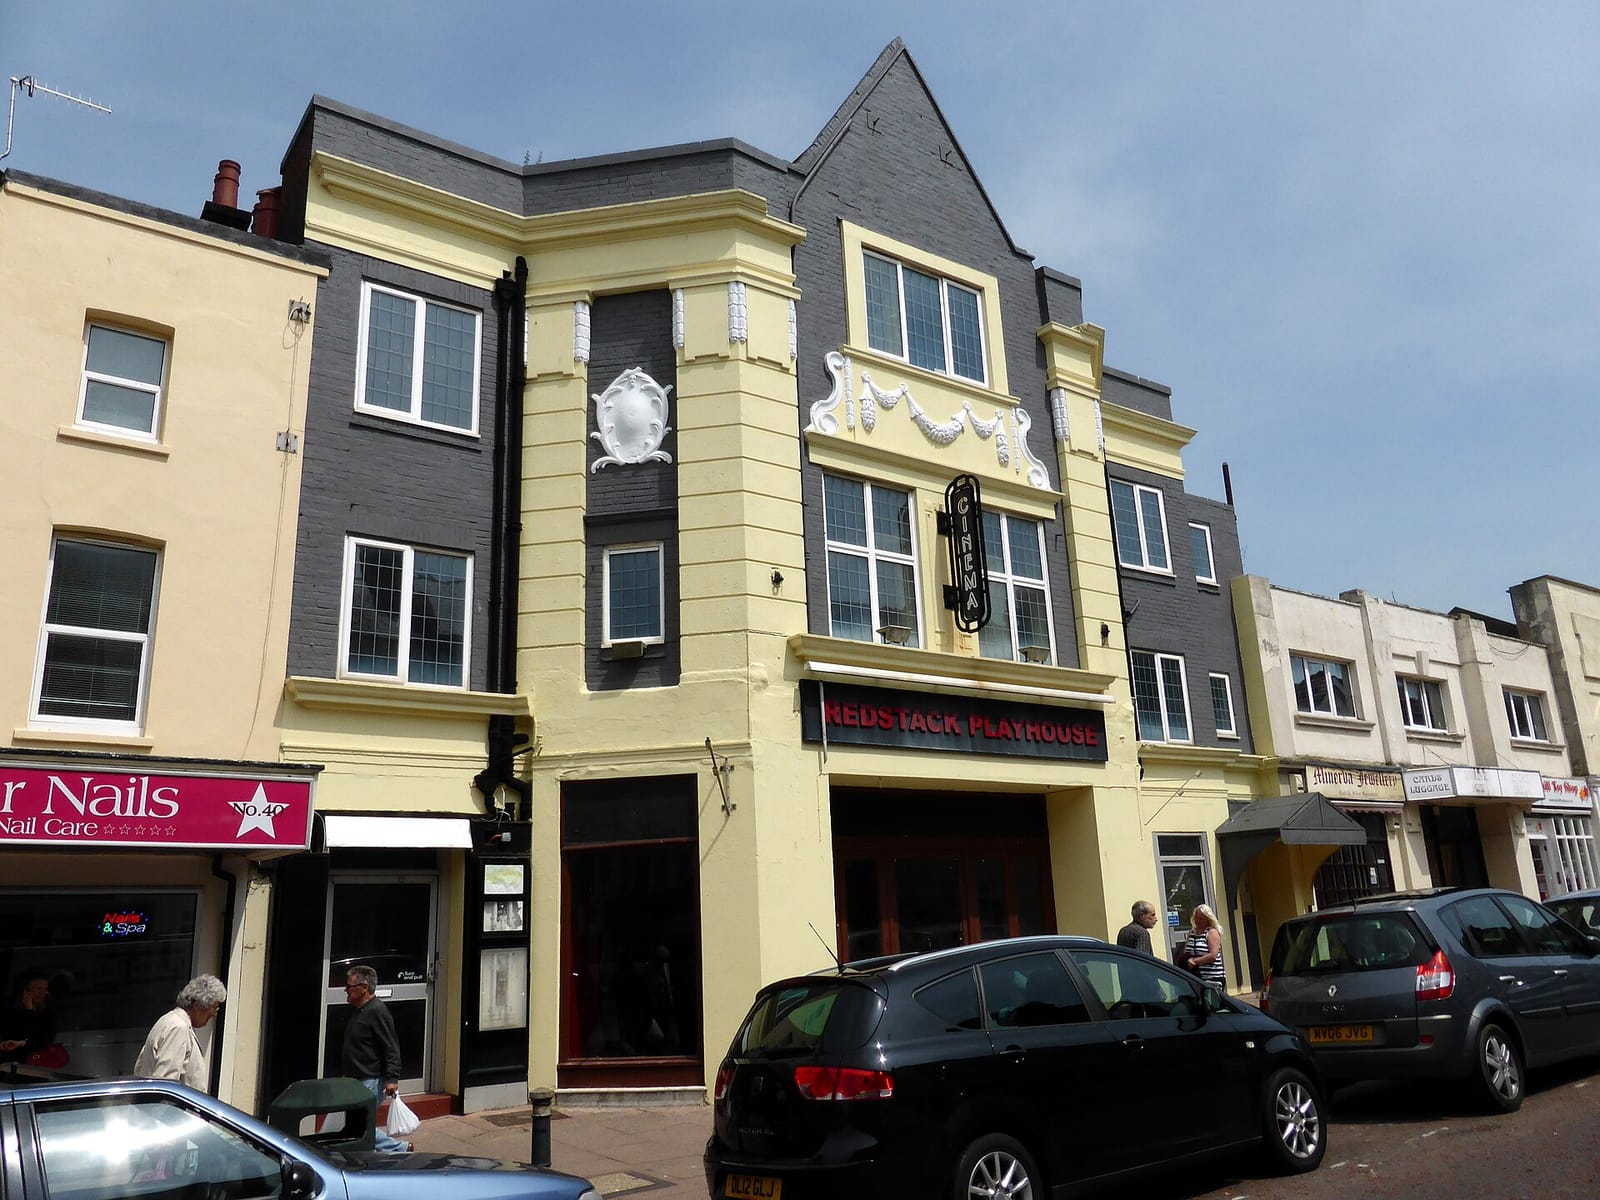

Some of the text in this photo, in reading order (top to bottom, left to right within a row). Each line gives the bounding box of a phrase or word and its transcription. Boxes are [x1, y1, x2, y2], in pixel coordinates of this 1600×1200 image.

[957, 496, 979, 611] CINEMA
[825, 700, 1098, 746] REDSTACK PLAYHOUSE
[1313, 766, 1398, 788] Minerva Jewellery
[1412, 774, 1443, 784] CARDS
[41, 775, 180, 818] Nails
[1409, 784, 1450, 794] LUGGAGE
[0, 816, 98, 836] Nail Care
[103, 912, 140, 923] Nails
[103, 922, 146, 935] & Spa
[731, 1175, 752, 1195] DL12
